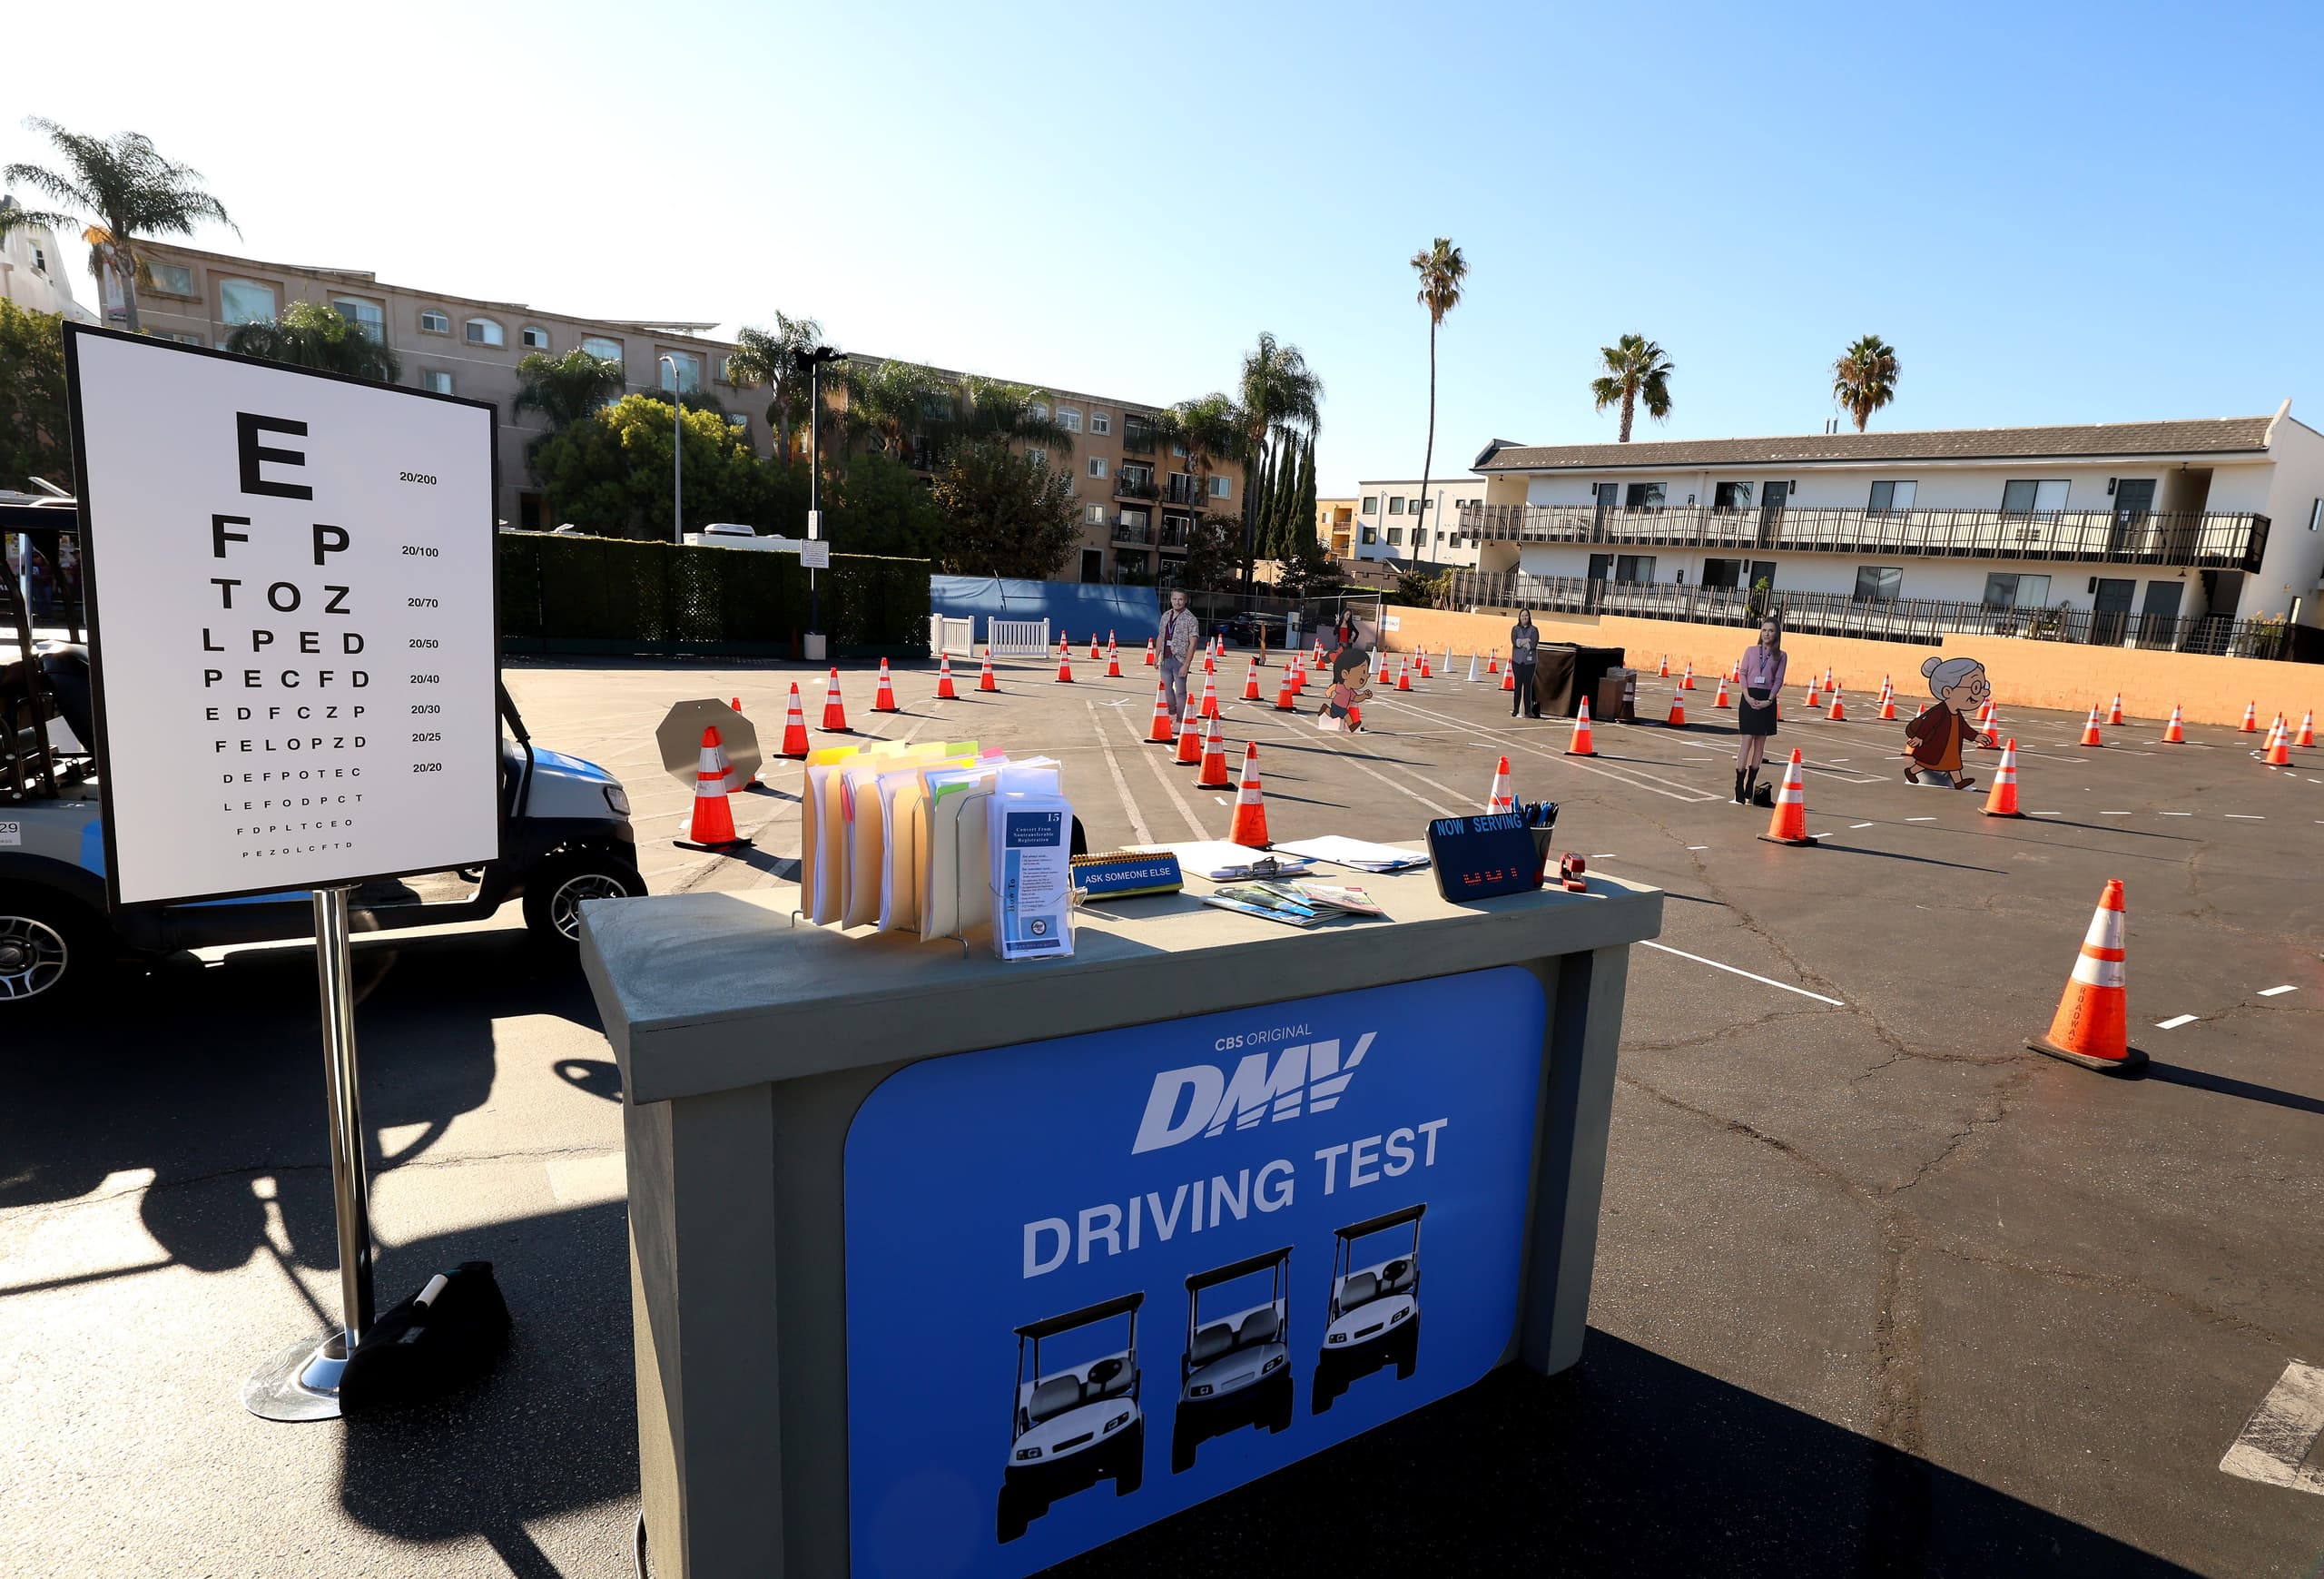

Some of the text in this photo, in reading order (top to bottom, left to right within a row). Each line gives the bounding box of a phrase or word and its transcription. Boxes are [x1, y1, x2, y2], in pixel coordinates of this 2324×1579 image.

[236, 411, 312, 500] E
[399, 471, 437, 486] 20/200
[401, 546, 438, 558] 20/100
[408, 597, 438, 608] 20/70
[409, 638, 438, 649] 20/50
[409, 674, 440, 685] 20/40
[411, 704, 440, 715] 20/30
[412, 732, 441, 743] 20/25
[413, 762, 442, 774] 20/20
[1048, 813, 1060, 822] 15
[1436, 814, 1522, 836] NOW SERVING
[1085, 867, 1172, 884] ASK SOMEONE ELSE
[1215, 1023, 1313, 1051] CBS ORIGINAL
[1131, 1031, 1377, 1155] DMV
[1023, 1118, 1448, 1279] DRIVING TEST
